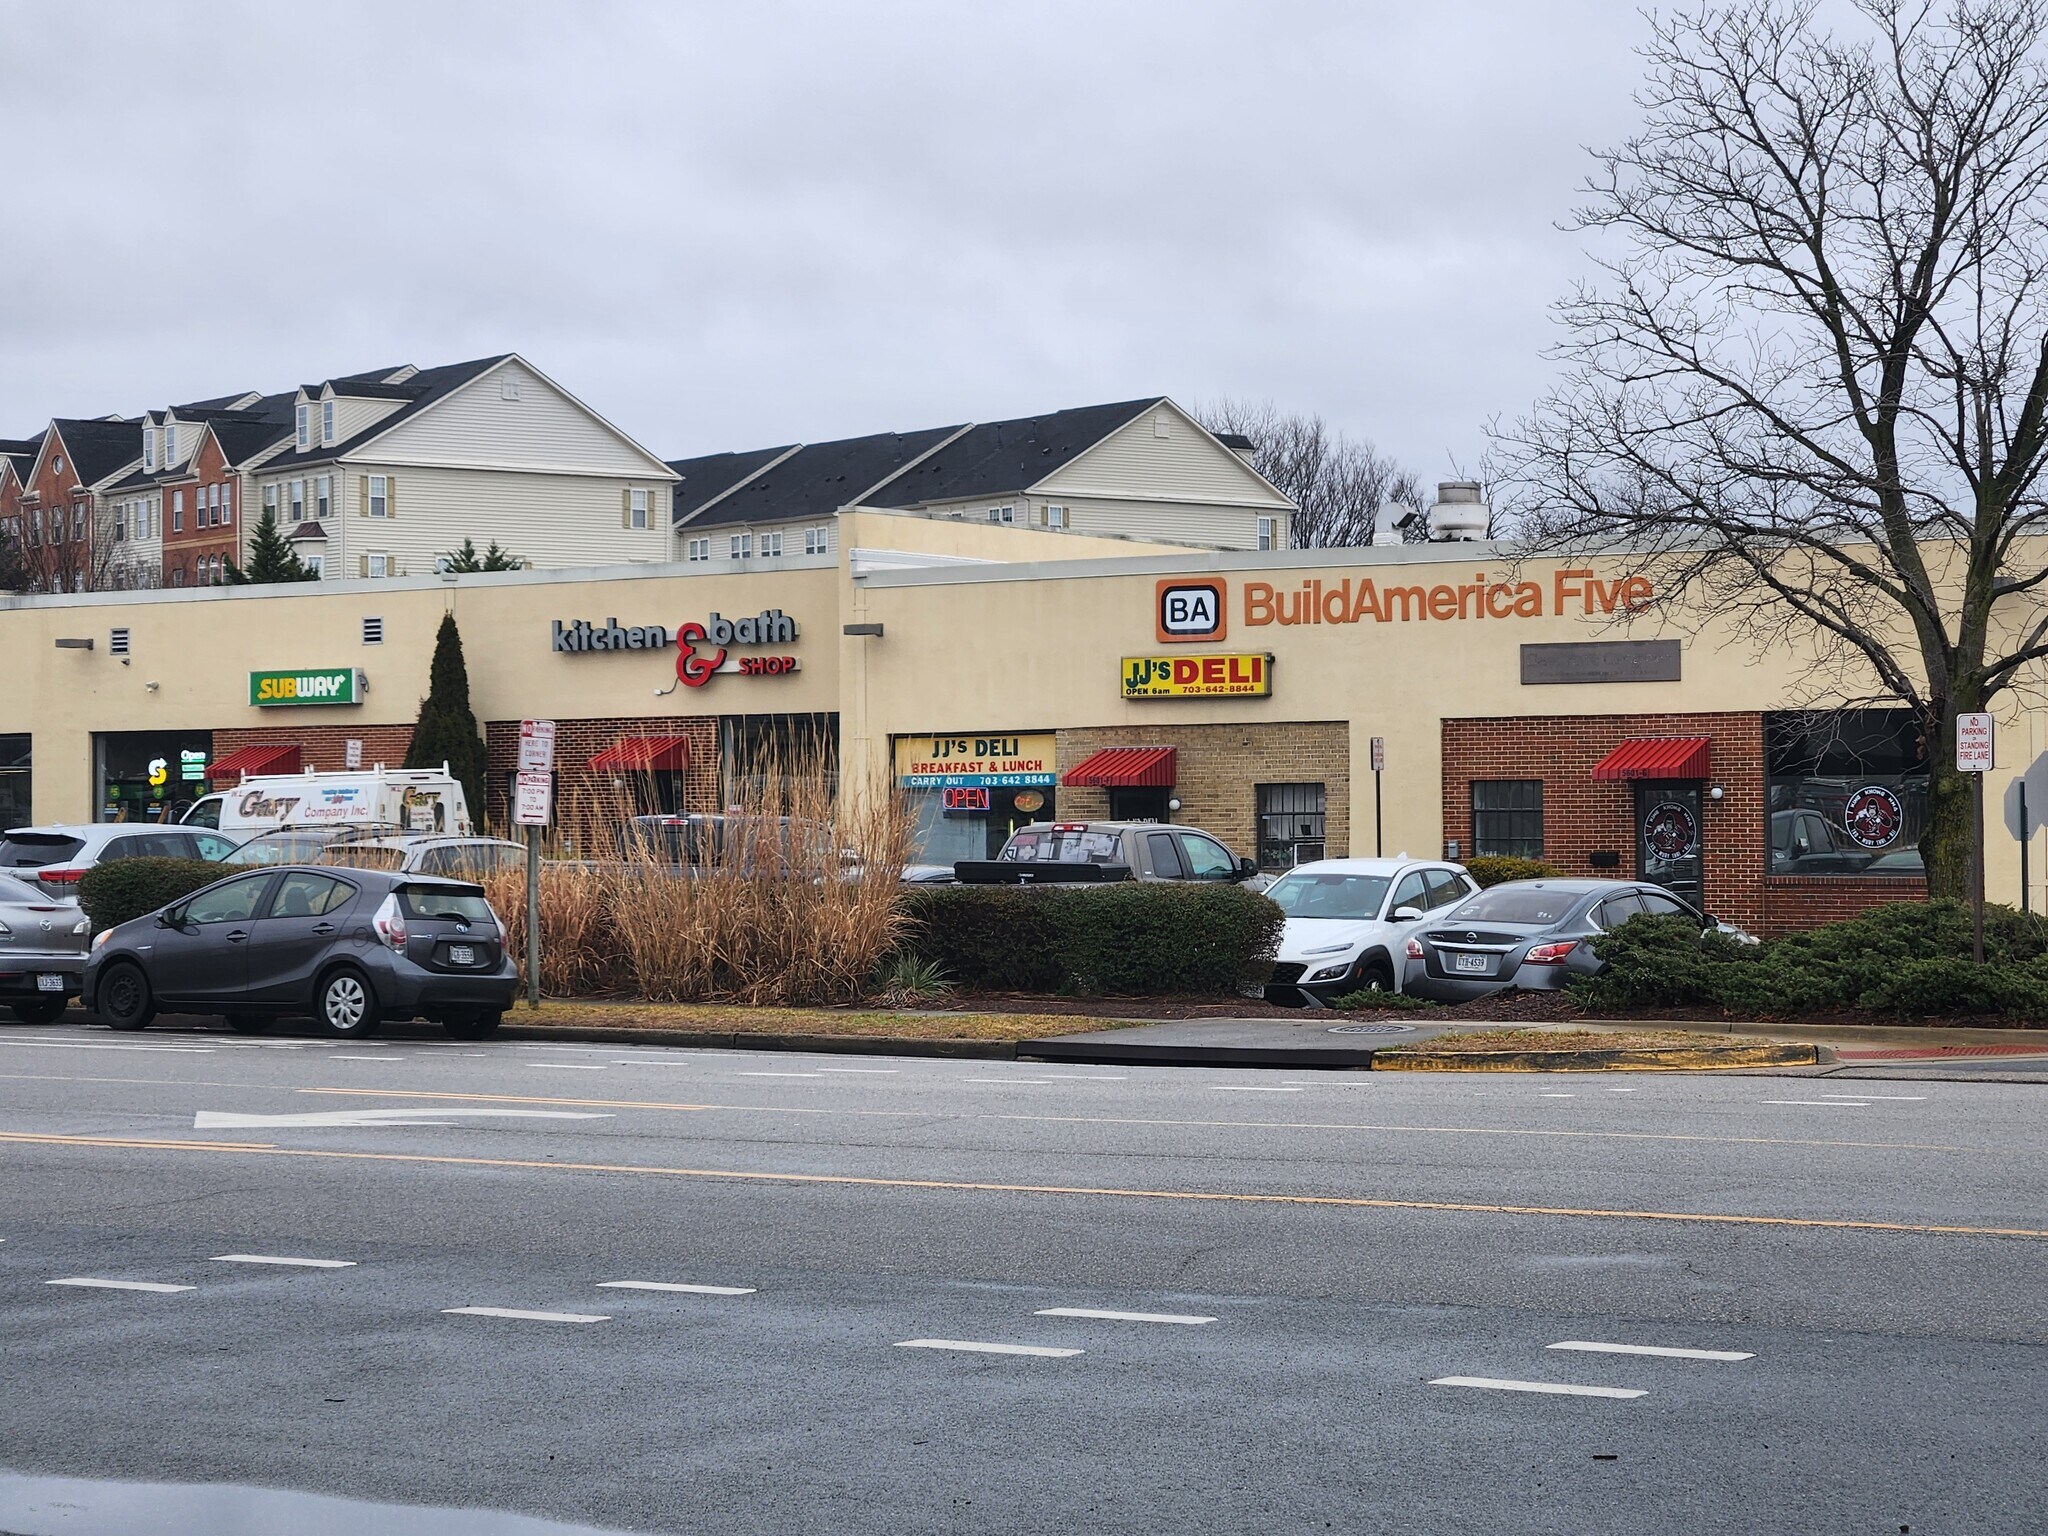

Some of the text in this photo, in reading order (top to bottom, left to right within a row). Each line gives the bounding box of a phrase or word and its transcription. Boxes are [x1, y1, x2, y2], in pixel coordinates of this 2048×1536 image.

[1244, 569, 1654, 626] BuildAmerica Five
[1169, 596, 1211, 623] BA
[551, 609, 797, 687] kitchen & bath
[738, 656, 796, 675] SHOP
[1125, 657, 1262, 688] JJ'S DELI
[257, 674, 346, 700] SUBWAY
[1182, 685, 1255, 693] 703-642-8844
[1969, 719, 1979, 727] NO
[1961, 727, 1987, 736] PARKING
[932, 738, 1019, 758] JJ'S DELI
[1960, 741, 1989, 750] STANDING
[181, 750, 206, 762] Open
[1960, 751, 1989, 760] FIRE LANE
[911, 760, 1042, 774] BREAKFAST & LUNCH
[911, 775, 1050, 785] CARRY OUT 703 642 8844
[239, 790, 300, 822] Gary
[944, 788, 989, 809] OPEN
[1887, 797, 1898, 812] MMA
[304, 805, 368, 819] Company Inc.
[1683, 812, 1693, 827] MMA
